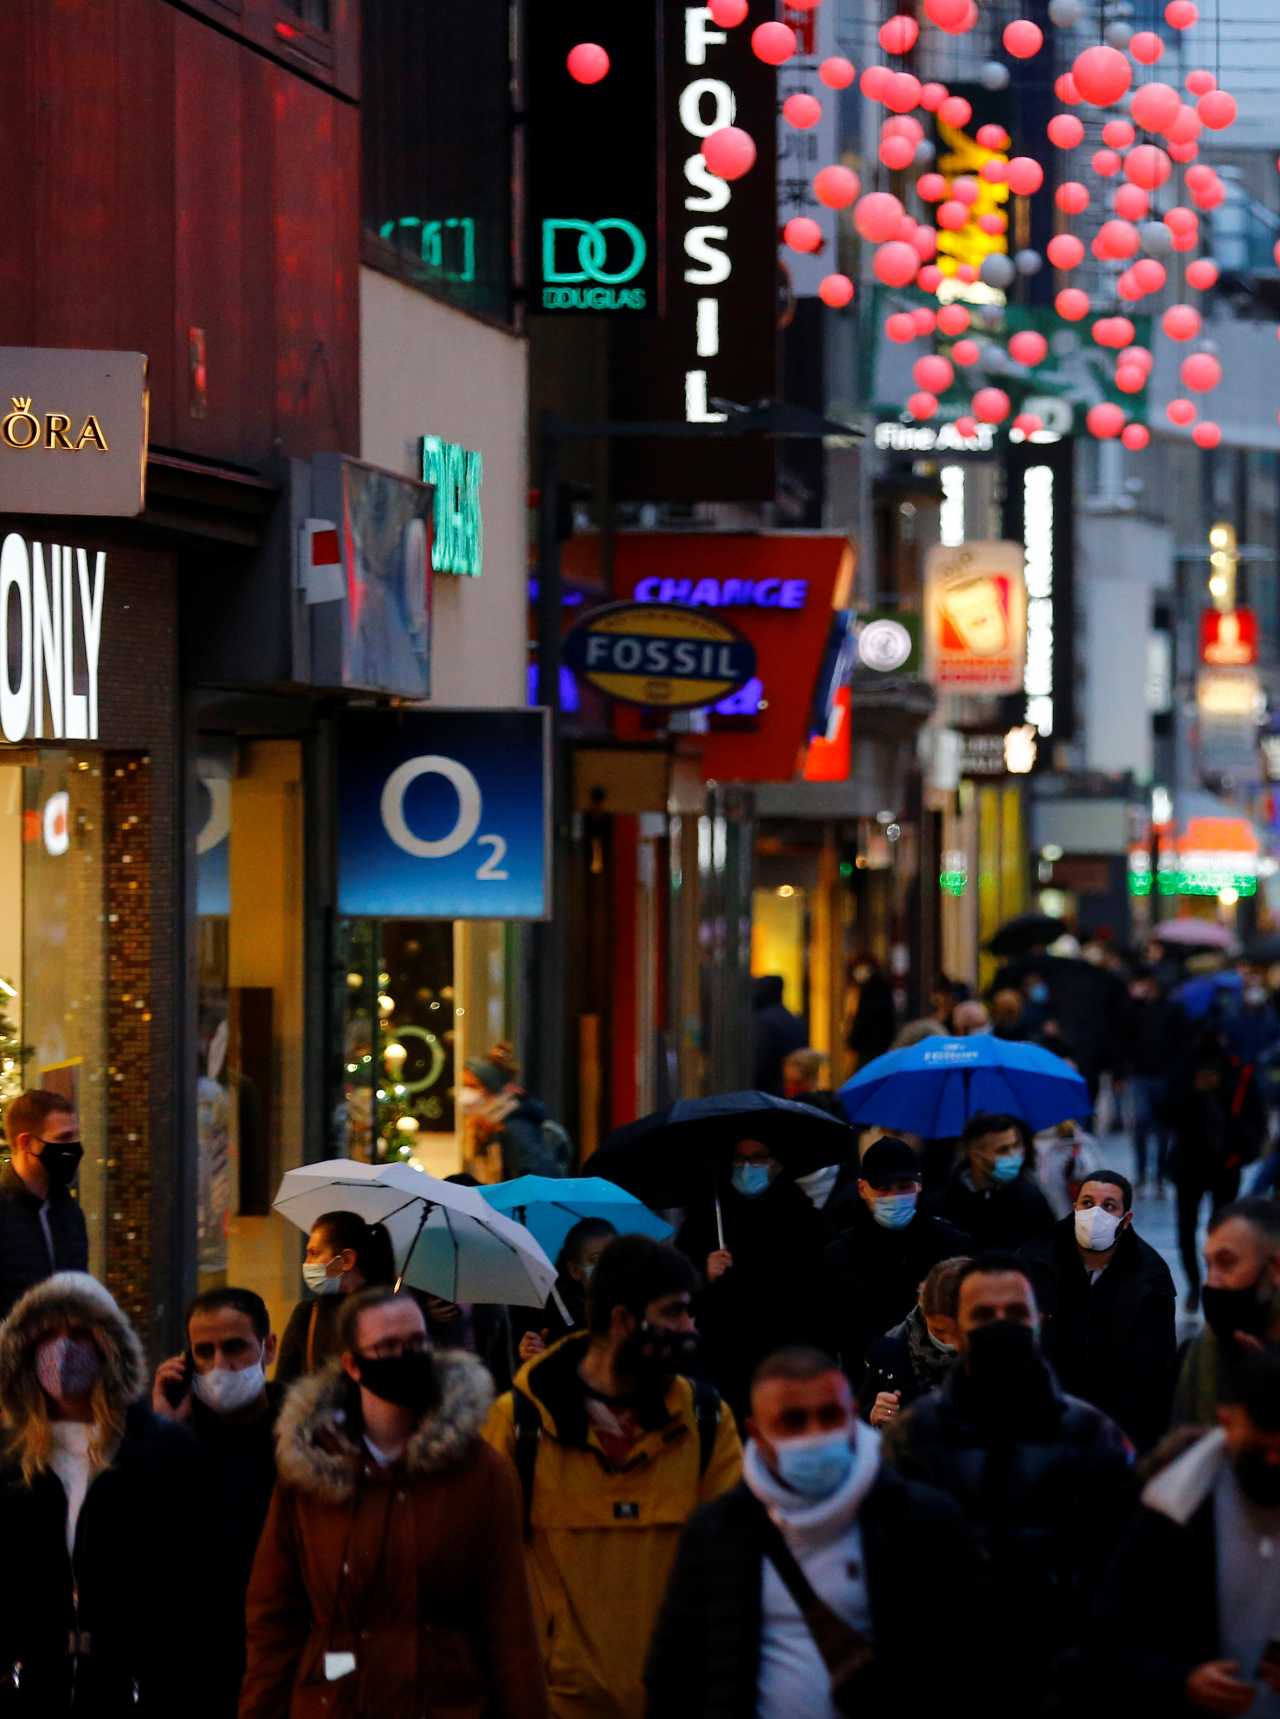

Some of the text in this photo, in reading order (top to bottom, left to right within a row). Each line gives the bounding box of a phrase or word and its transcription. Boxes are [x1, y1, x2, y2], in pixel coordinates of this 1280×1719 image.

[678, 6, 737, 423] FOSSIL
[542, 287, 647, 310] DOUGLAS
[0, 532, 107, 743] ONLY
[585, 636, 740, 678] FOSSIL
